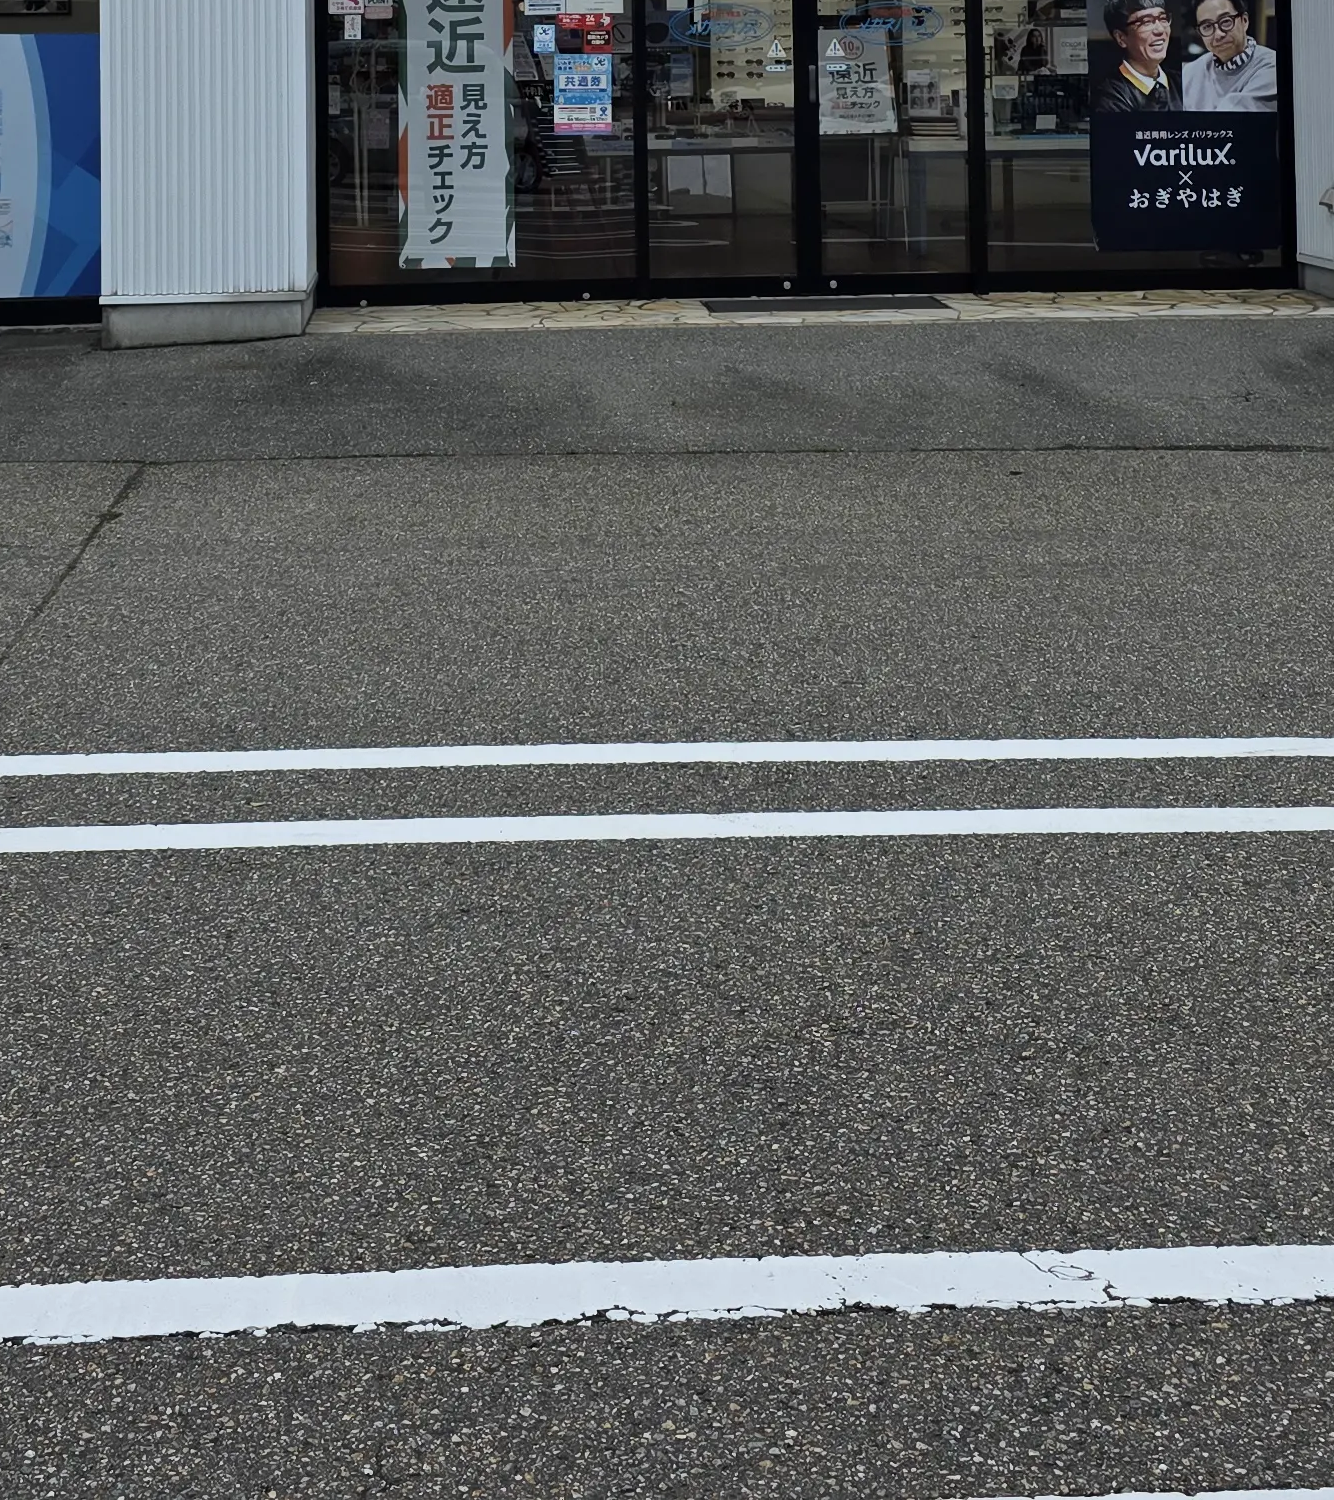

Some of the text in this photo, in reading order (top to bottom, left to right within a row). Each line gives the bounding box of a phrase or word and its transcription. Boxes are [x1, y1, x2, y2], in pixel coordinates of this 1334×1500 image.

[564, 76, 601, 87] 共通券
[829, 62, 878, 84] 遠近
[836, 86, 875, 99] 見え方
[460, 83, 488, 170] 見え方
[1192, 130, 1234, 139] バリラックス
[426, 84, 454, 245] 適正チェック
[1133, 143, 1233, 167] Varilux
[1129, 186, 1244, 209] おぎやはぎ
